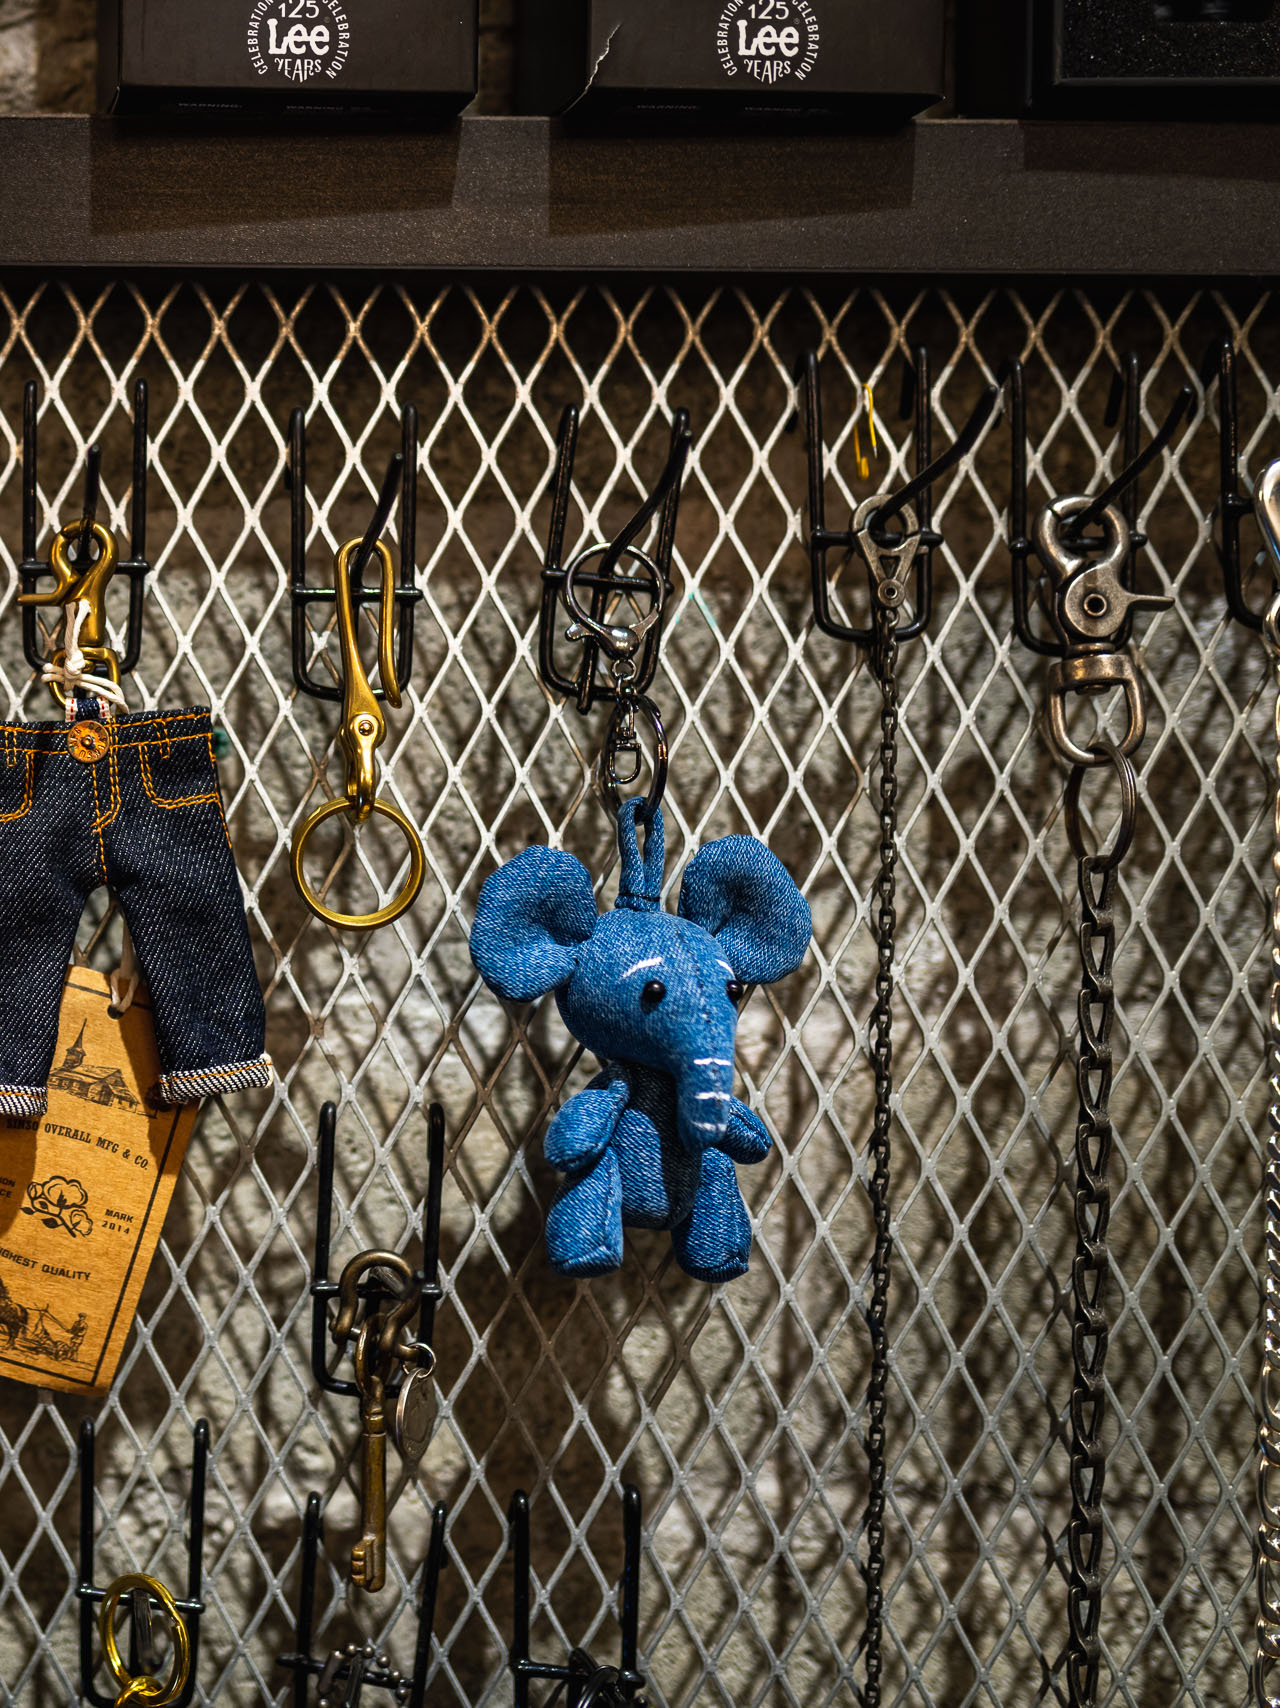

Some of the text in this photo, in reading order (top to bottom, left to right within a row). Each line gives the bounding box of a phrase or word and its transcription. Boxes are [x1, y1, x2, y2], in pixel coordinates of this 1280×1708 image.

[278, 0, 320, 18] 125
[748, 0, 790, 19] 125
[266, 18, 330, 55] Lee
[736, 19, 800, 57] Lee
[274, 57, 322, 83] YEARS
[743, 58, 791, 84] YEARS
[44, 1122, 92, 1144] OVERALL
[95, 1136, 119, 1154] MFG
[122, 1148, 131, 1159] &
[134, 1155, 149, 1170] CO.
[104, 1208, 135, 1223] MARK
[101, 1220, 131, 1235] 2014
[41, 1263, 91, 1281] QUALITY
